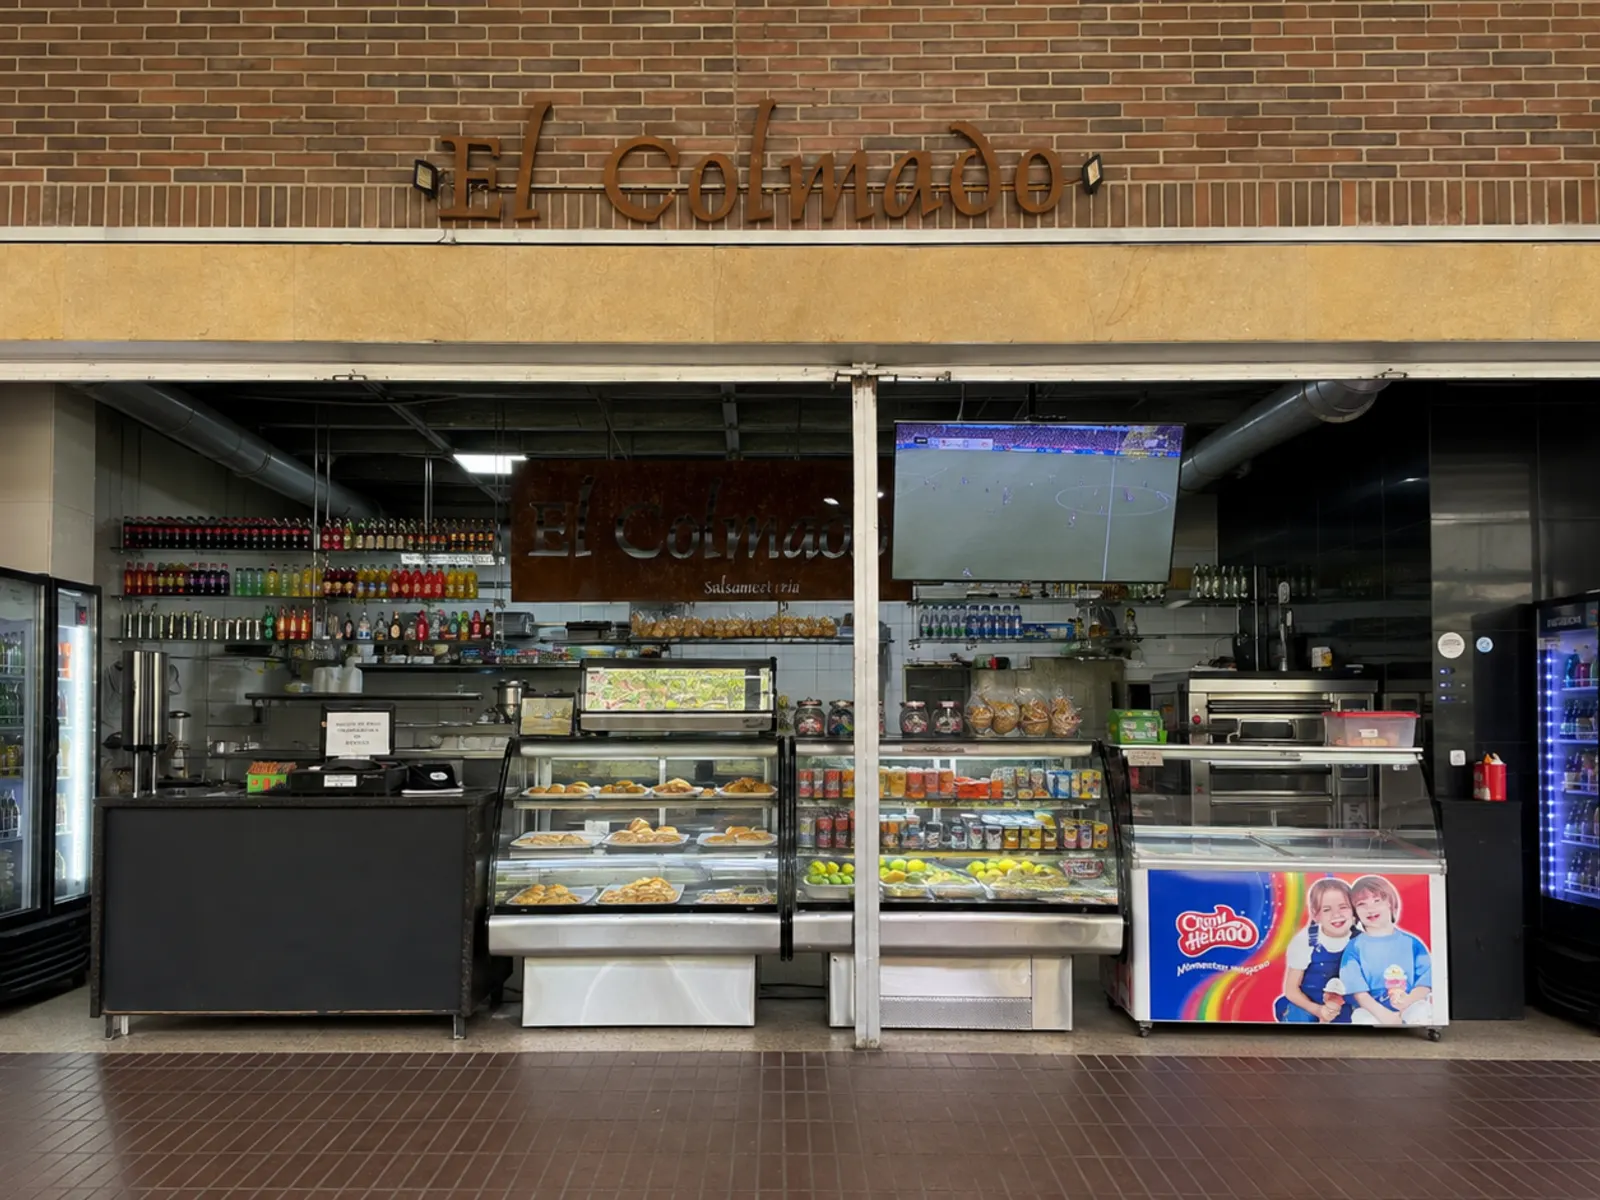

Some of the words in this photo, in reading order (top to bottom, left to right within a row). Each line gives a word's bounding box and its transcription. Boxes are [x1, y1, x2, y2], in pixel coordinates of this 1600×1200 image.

[439, 100, 552, 221] El
[603, 99, 1064, 223] Colmado
[528, 475, 595, 558] El
